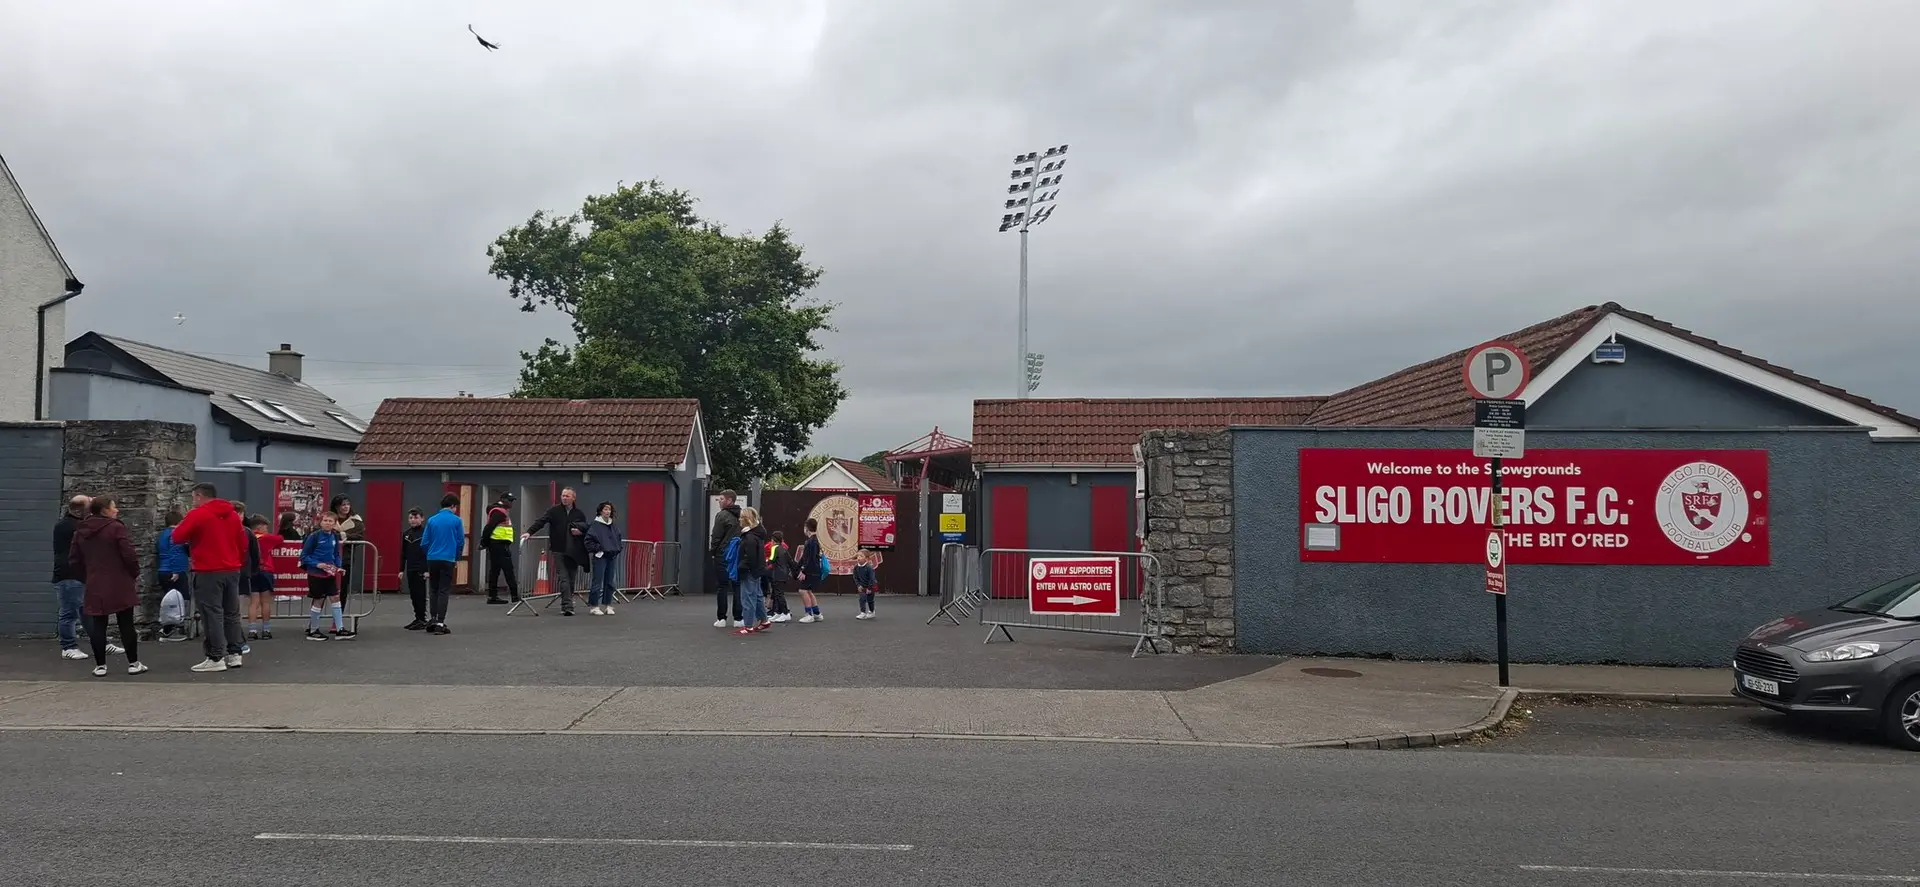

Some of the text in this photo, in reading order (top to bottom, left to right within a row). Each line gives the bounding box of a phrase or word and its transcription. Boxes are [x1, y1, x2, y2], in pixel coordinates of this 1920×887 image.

[1485, 352, 1512, 392] P
[1367, 462, 1582, 478] Welcome to the Sowgrounds
[1661, 463, 1742, 495] SLIGO ROVERS
[1315, 485, 1412, 525] SLIGO
[1566, 486, 1630, 526] F.C.
[1539, 532, 1567, 548] BIT
[1571, 532, 1630, 548] O'RED
[1662, 522, 1742, 551] FOOTBALL CLUB
[1050, 566, 1113, 575] AWAY SUPPORTERS
[1036, 582, 1112, 591] ENTER VIA ASTRO GATE
